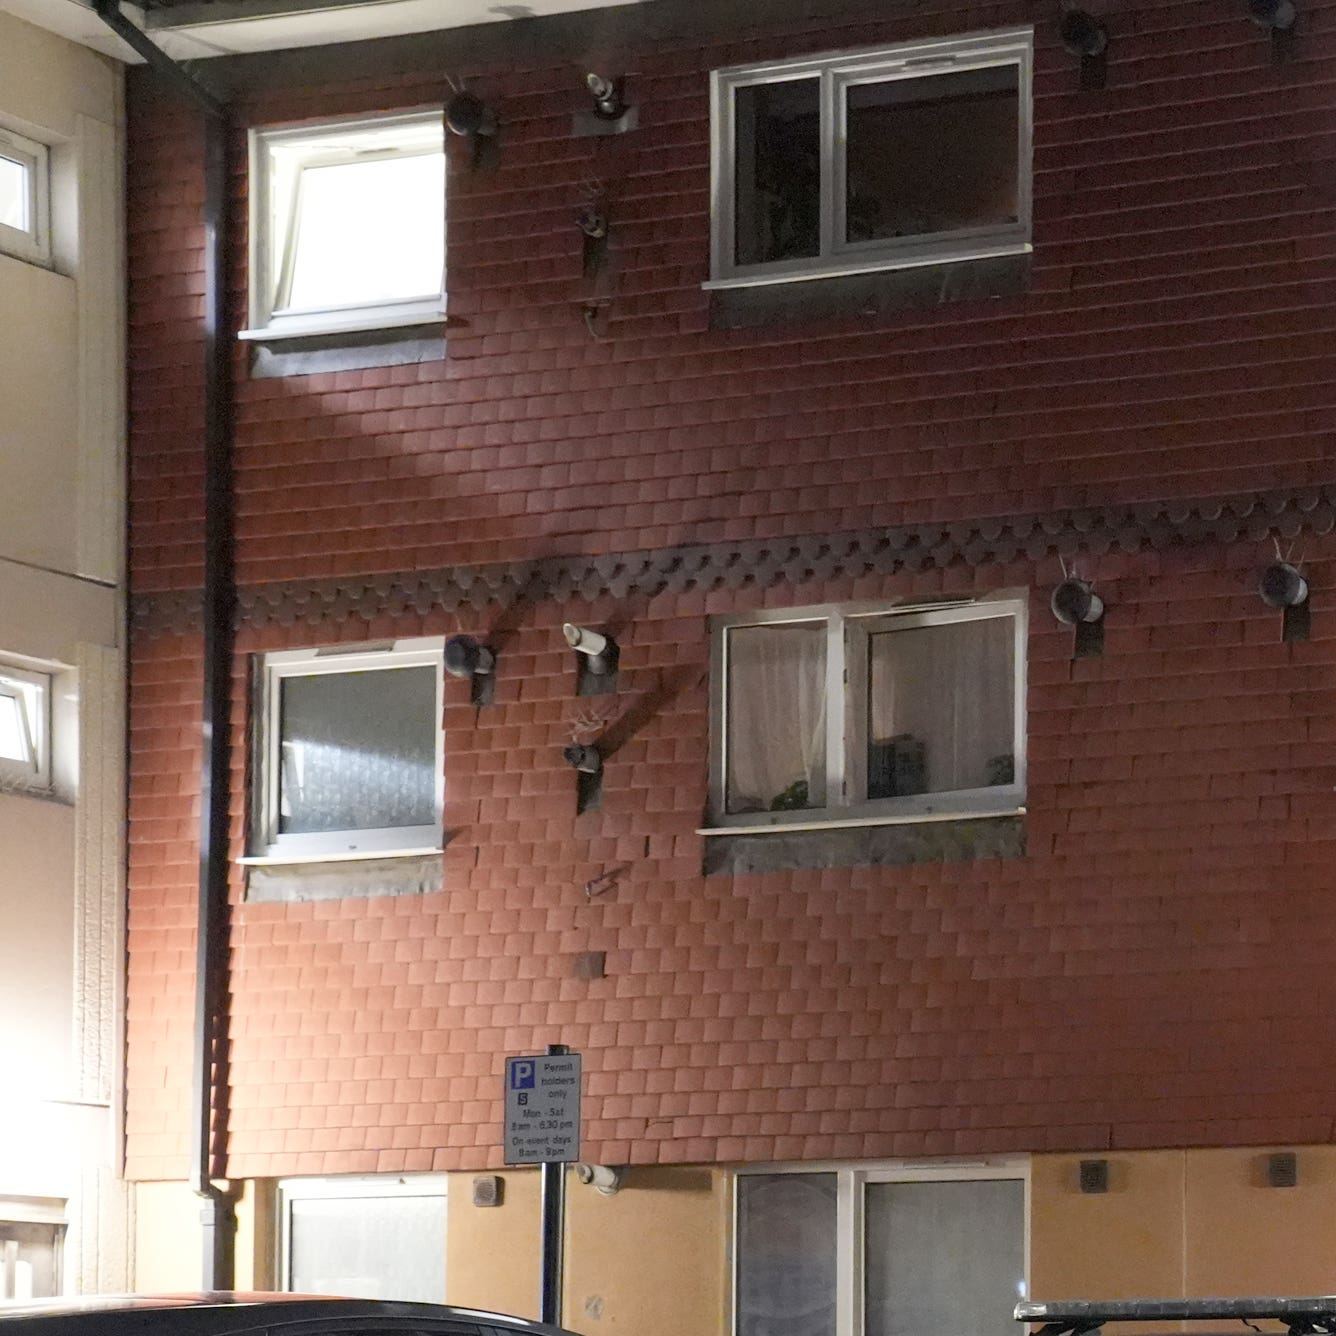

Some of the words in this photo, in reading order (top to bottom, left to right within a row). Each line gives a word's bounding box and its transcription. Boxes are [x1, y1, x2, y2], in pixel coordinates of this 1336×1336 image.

[544, 1063, 573, 1072] Permit
[514, 1062, 532, 1088] P
[541, 1076, 575, 1086] holders
[548, 1090, 567, 1100] only
[523, 1109, 541, 1118] Mon
[549, 1107, 564, 1117] Sat
[512, 1136, 524, 1146] On
[527, 1136, 549, 1145] event
[552, 1135, 571, 1146] days
